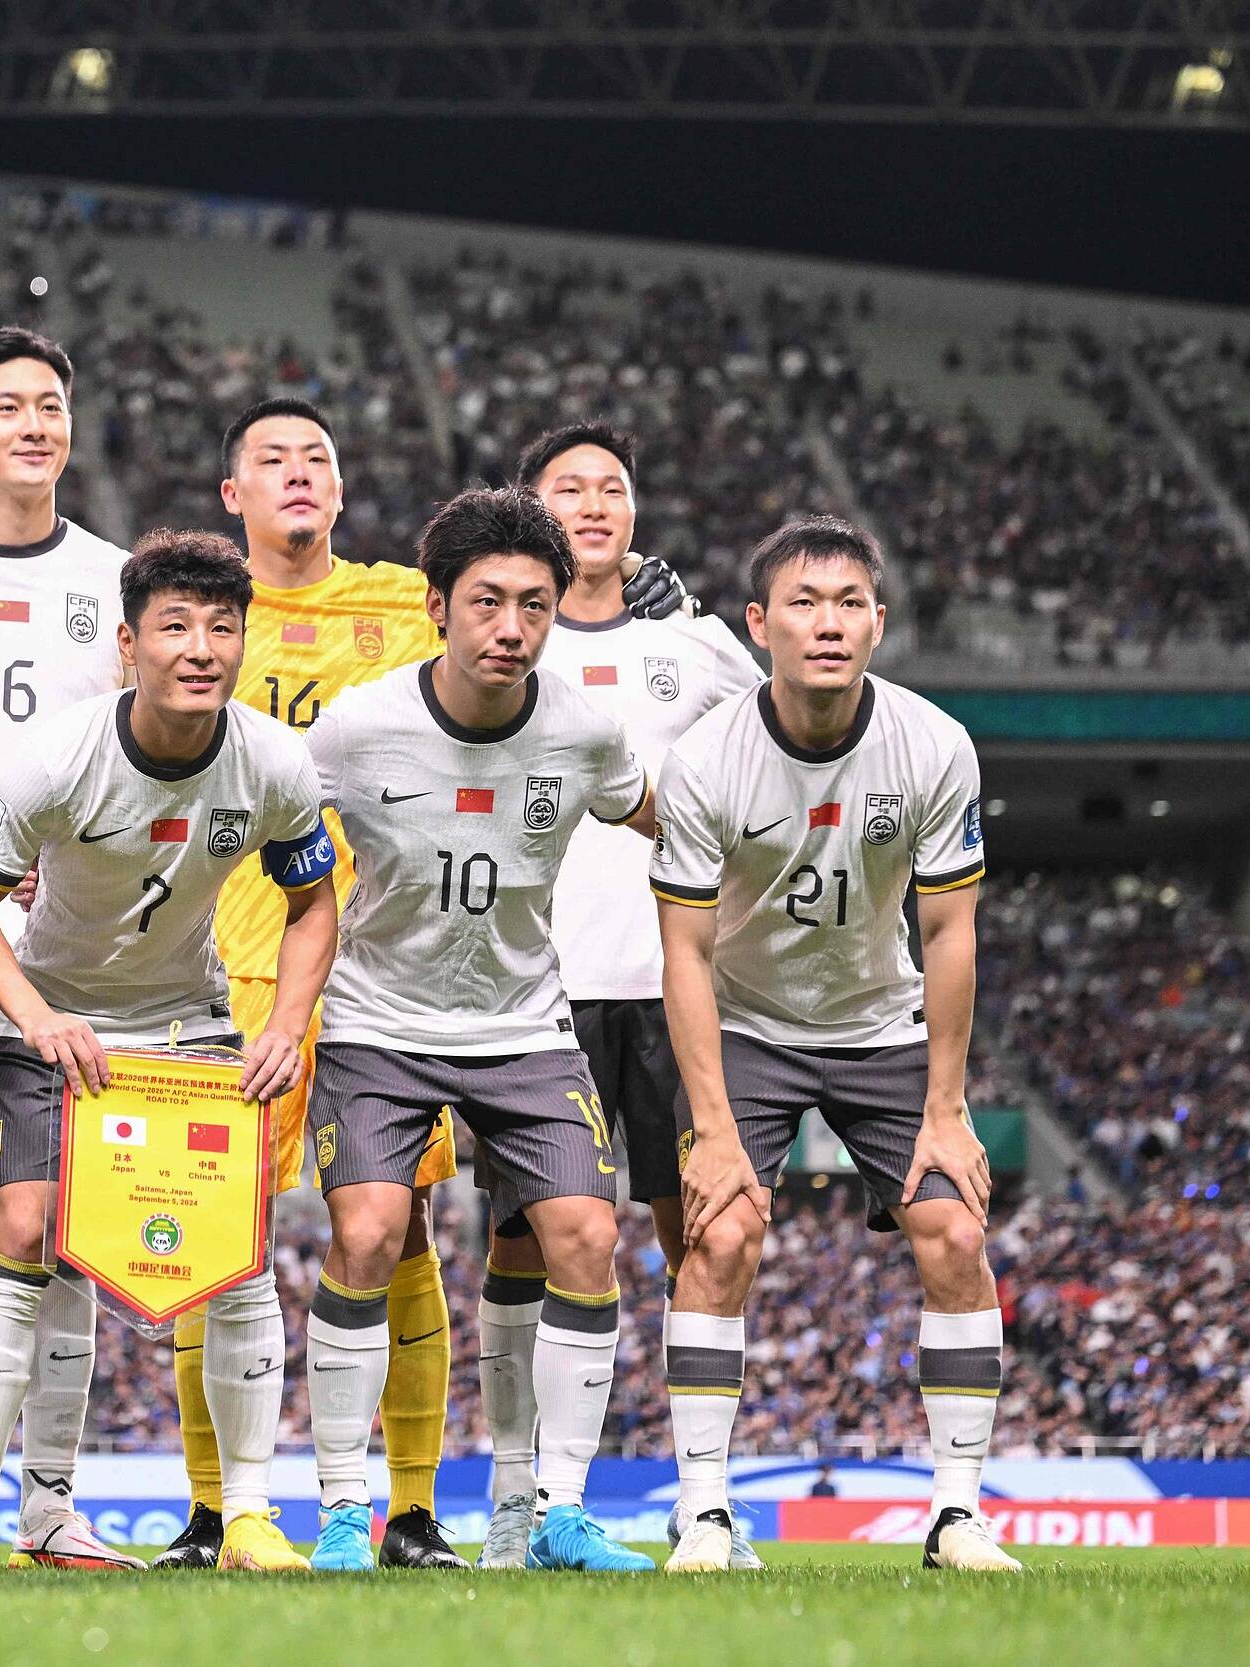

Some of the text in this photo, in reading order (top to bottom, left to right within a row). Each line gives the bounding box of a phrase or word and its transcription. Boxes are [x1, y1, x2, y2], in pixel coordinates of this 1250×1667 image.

[70, 596, 96, 608] CFA
[265, 676, 320, 728] 14
[530, 780, 559, 790] CFA
[869, 797, 899, 808] CFA
[214, 812, 245, 823] CFA
[283, 835, 333, 876] AFC
[437, 850, 498, 916] 10
[786, 864, 848, 927] 21
[138, 873, 173, 933] 7
[108, 1083, 130, 1092] World
[131, 1085, 146, 1095] Cup
[172, 1089, 188, 1097] AFC
[188, 1091, 209, 1099] Asian
[146, 1095, 189, 1106] ROAD TO 26
[114, 1152, 132, 1163] 日本
[110, 1164, 136, 1173] Japan
[198, 1160, 217, 1171] 中国
[158, 1169, 171, 1177] VS
[188, 1172, 226, 1182] China PR
[135, 1184, 193, 1197] Saitama, Japan
[128, 1194, 170, 1204] September
[180, 1198, 198, 1207] 2024
[155, 1238, 167, 1246] CFA
[257, 1357, 272, 1370] 7
